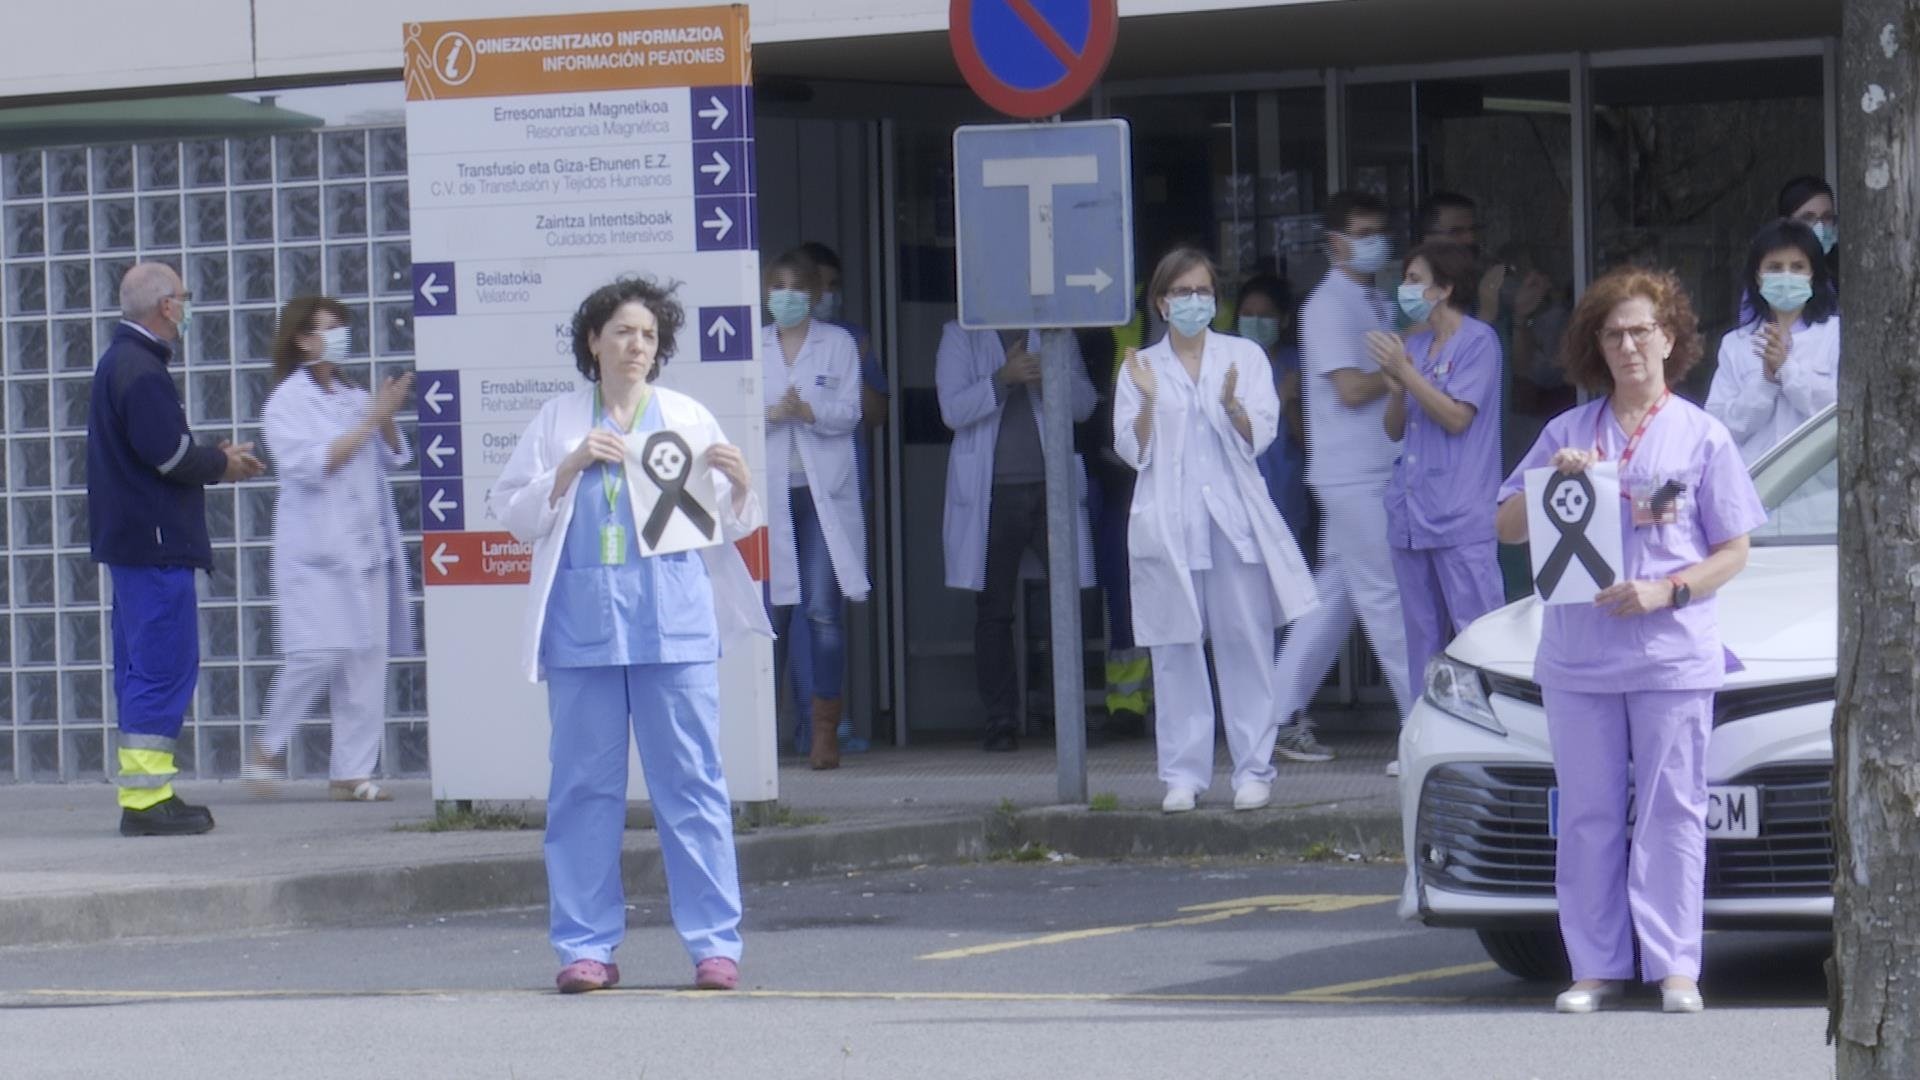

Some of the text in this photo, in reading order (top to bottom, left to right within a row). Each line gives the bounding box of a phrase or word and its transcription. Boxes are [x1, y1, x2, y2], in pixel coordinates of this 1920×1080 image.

[475, 25, 724, 55] OINEZKOENTZAKO INFORMAZIOA
[542, 46, 725, 73] INFORMACIÓN PEATONES
[494, 99, 669, 121] Erresonantzia Magnetikoa
[526, 118, 670, 140] Resonancia Magnética
[457, 153, 671, 178] Transfusio eta Giza-Ehunen E.Z.
[458, 181, 476, 195] de
[478, 178, 550, 194] Transfusión
[563, 174, 607, 193] Tejidos
[610, 173, 673, 189] Humanos
[535, 210, 673, 230] Zaintza Intentsiboak
[545, 227, 674, 247] Cuidados Intensivos
[475, 270, 542, 287] Beilatokia
[480, 379, 576, 396] Erreabilitazioa
[482, 432, 519, 449] Ospit
